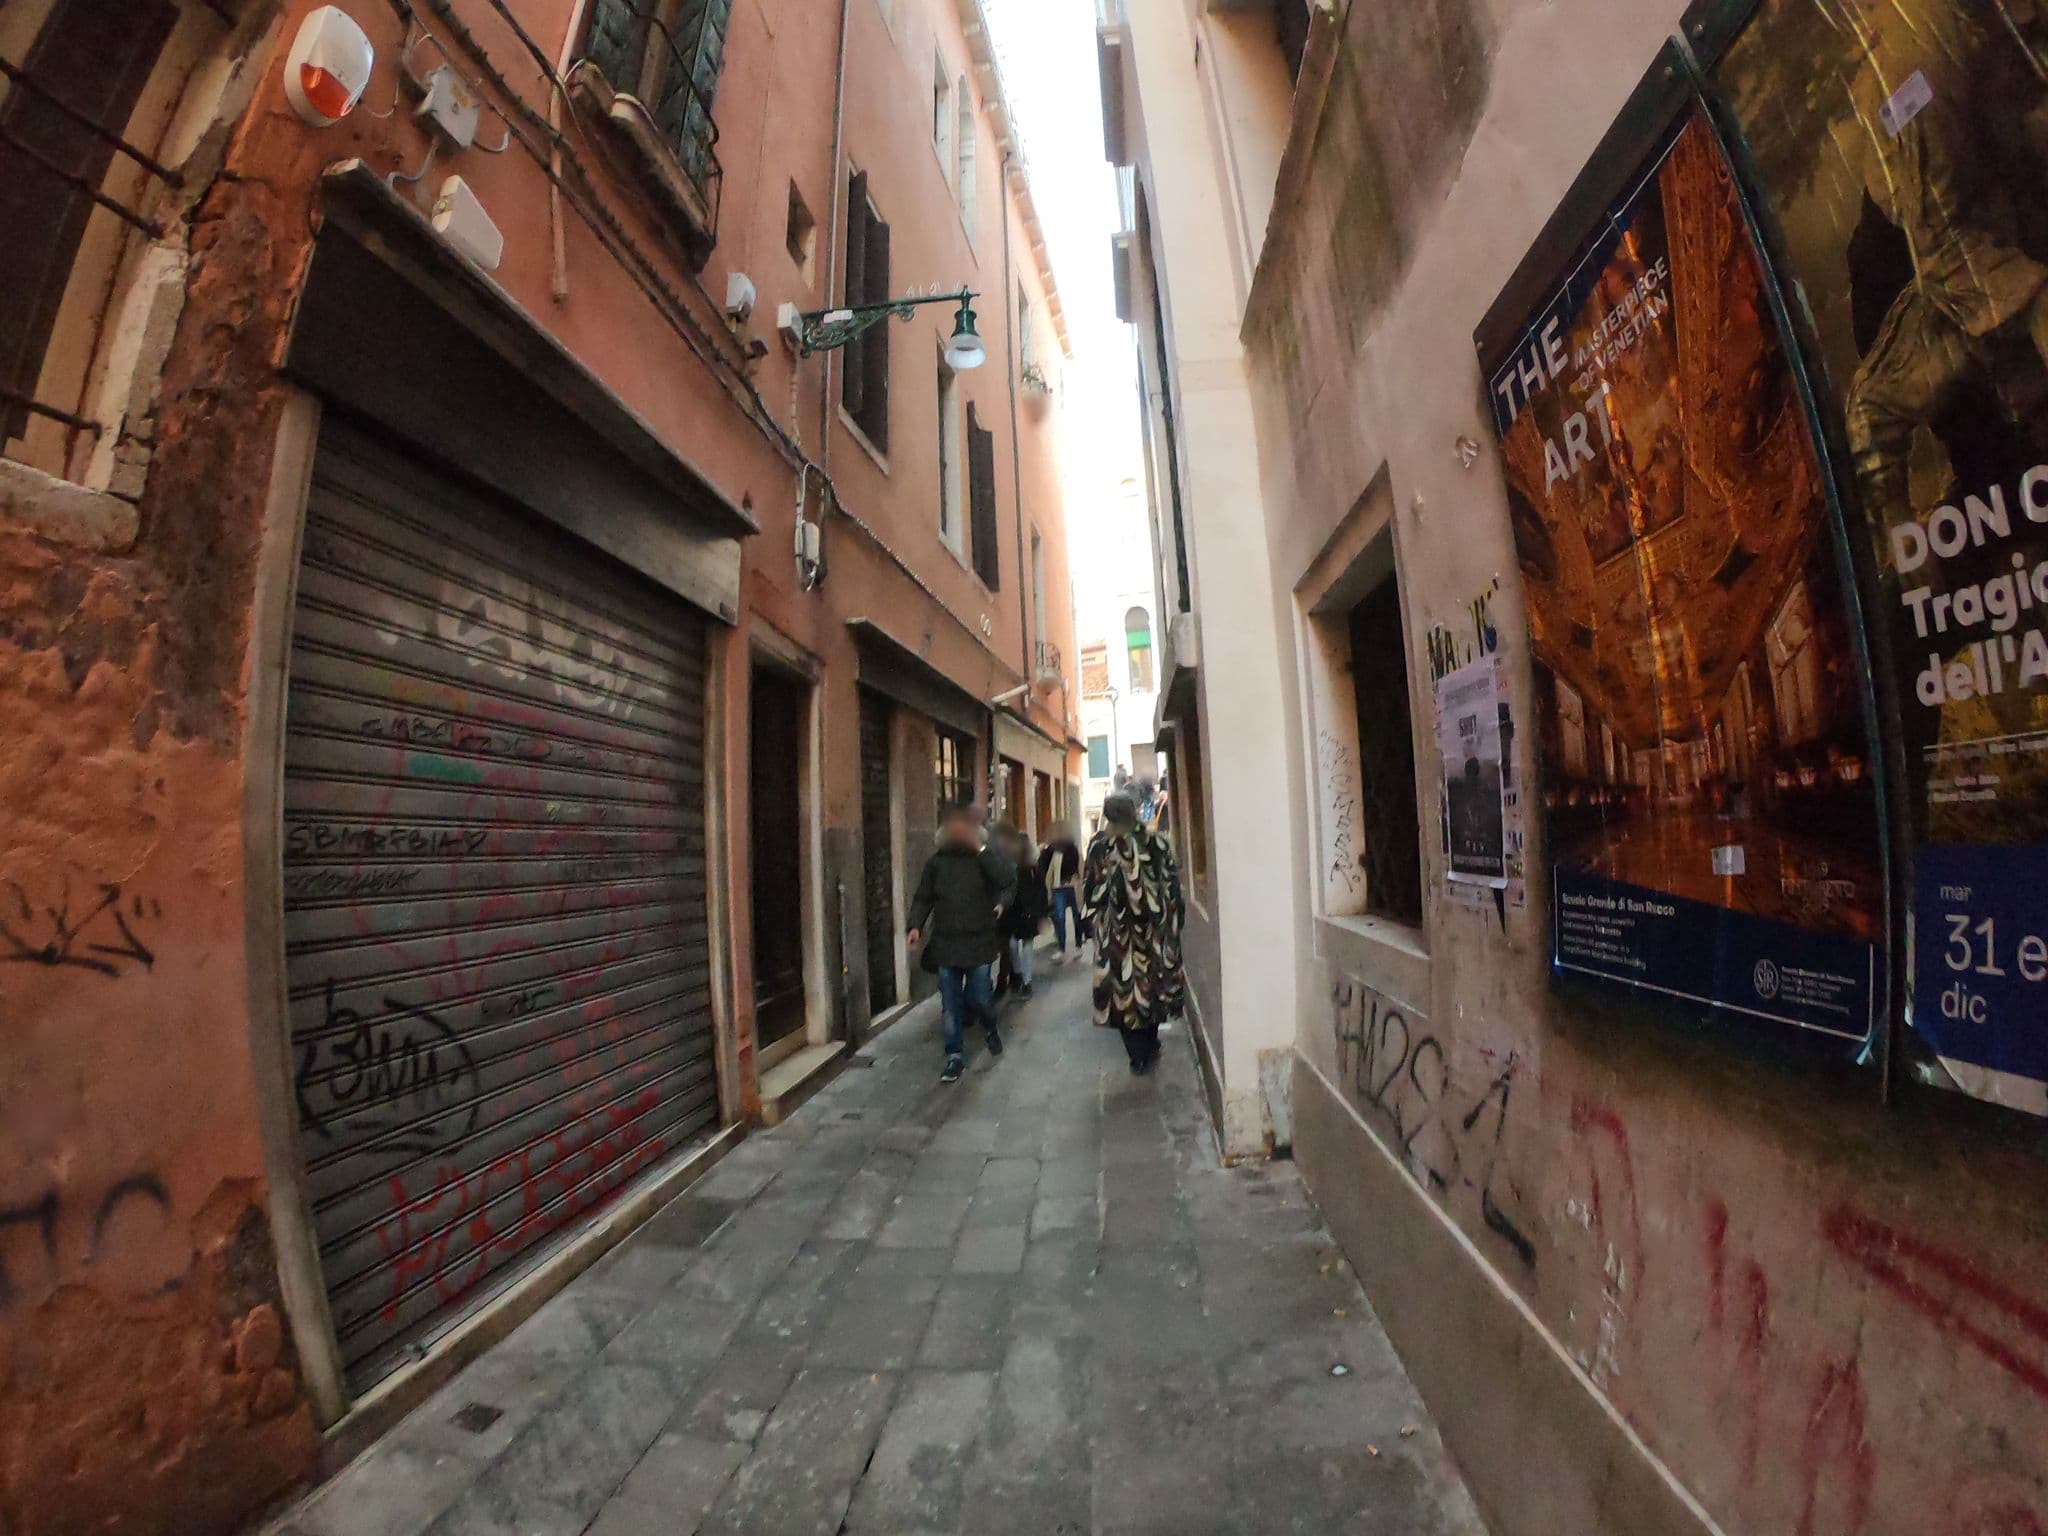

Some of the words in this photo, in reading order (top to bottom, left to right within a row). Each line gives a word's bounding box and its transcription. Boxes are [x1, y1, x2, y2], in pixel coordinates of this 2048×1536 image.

[1574, 256, 1669, 370] MASTERPIECE
[1579, 367, 1599, 391] OF
[1594, 289, 1669, 370] VENETIAN
[1498, 315, 1568, 422] THE
[1544, 380, 1612, 498] ART
[1892, 484, 2011, 573] DON
[1916, 629, 2048, 707] dell'A
[1940, 886, 1972, 901] mar
[1944, 914, 2005, 976] 31
[2017, 935, 2048, 981] e
[1941, 981, 1986, 1023] dic
